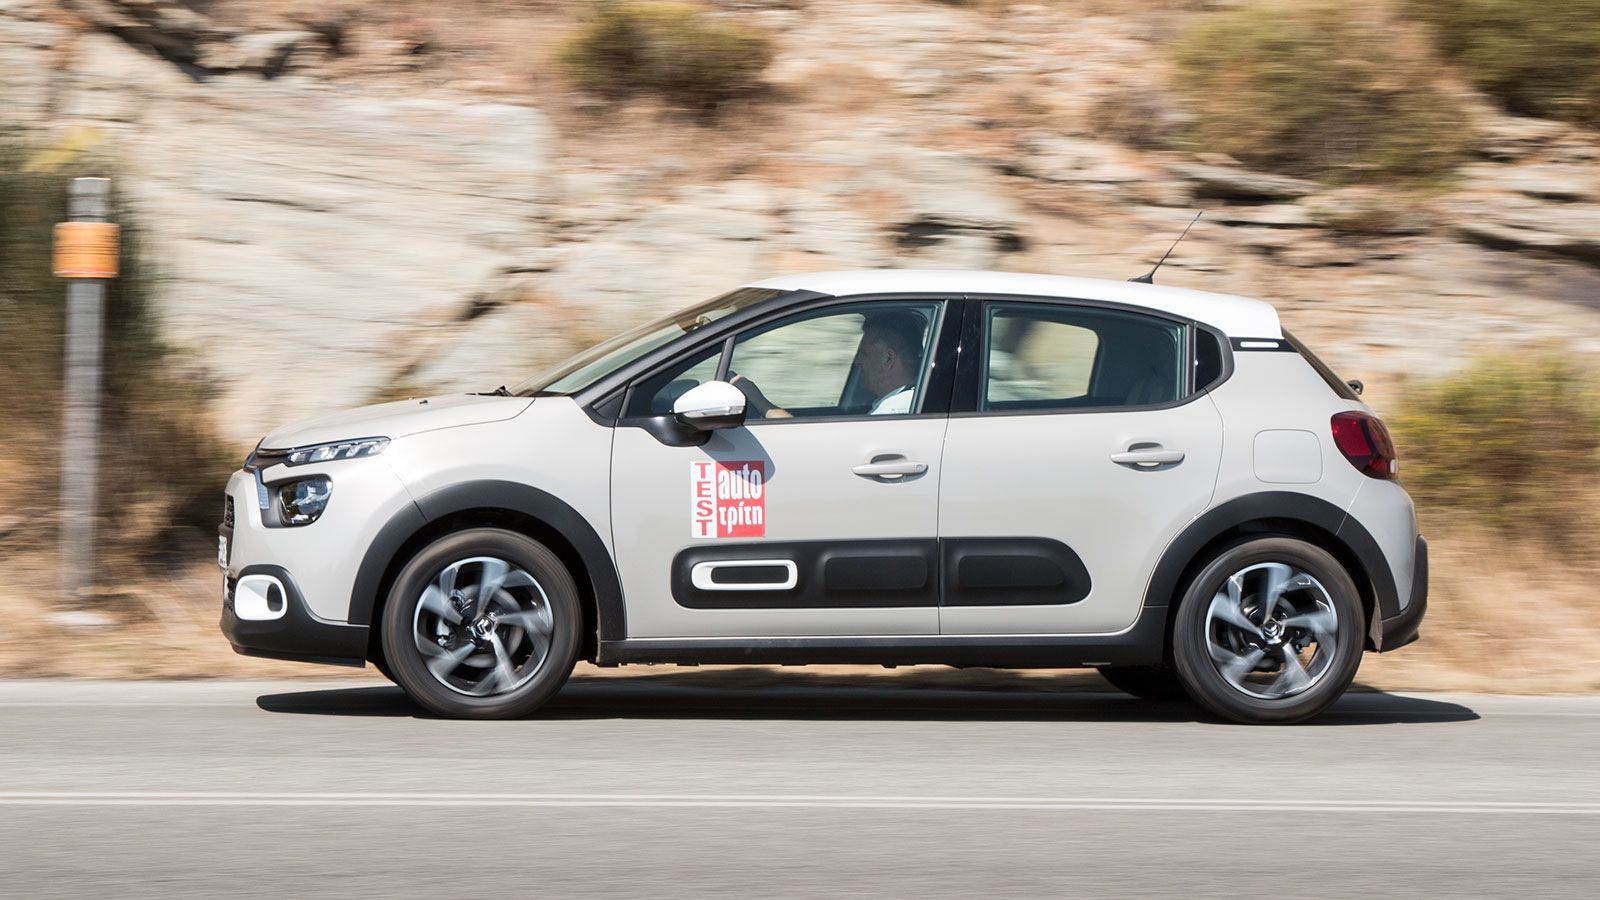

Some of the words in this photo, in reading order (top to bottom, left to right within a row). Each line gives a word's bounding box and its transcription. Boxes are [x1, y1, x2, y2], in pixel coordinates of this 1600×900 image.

[694, 462, 713, 536] TEST
[718, 463, 763, 500] auto
[719, 501, 763, 534] τρίτη
